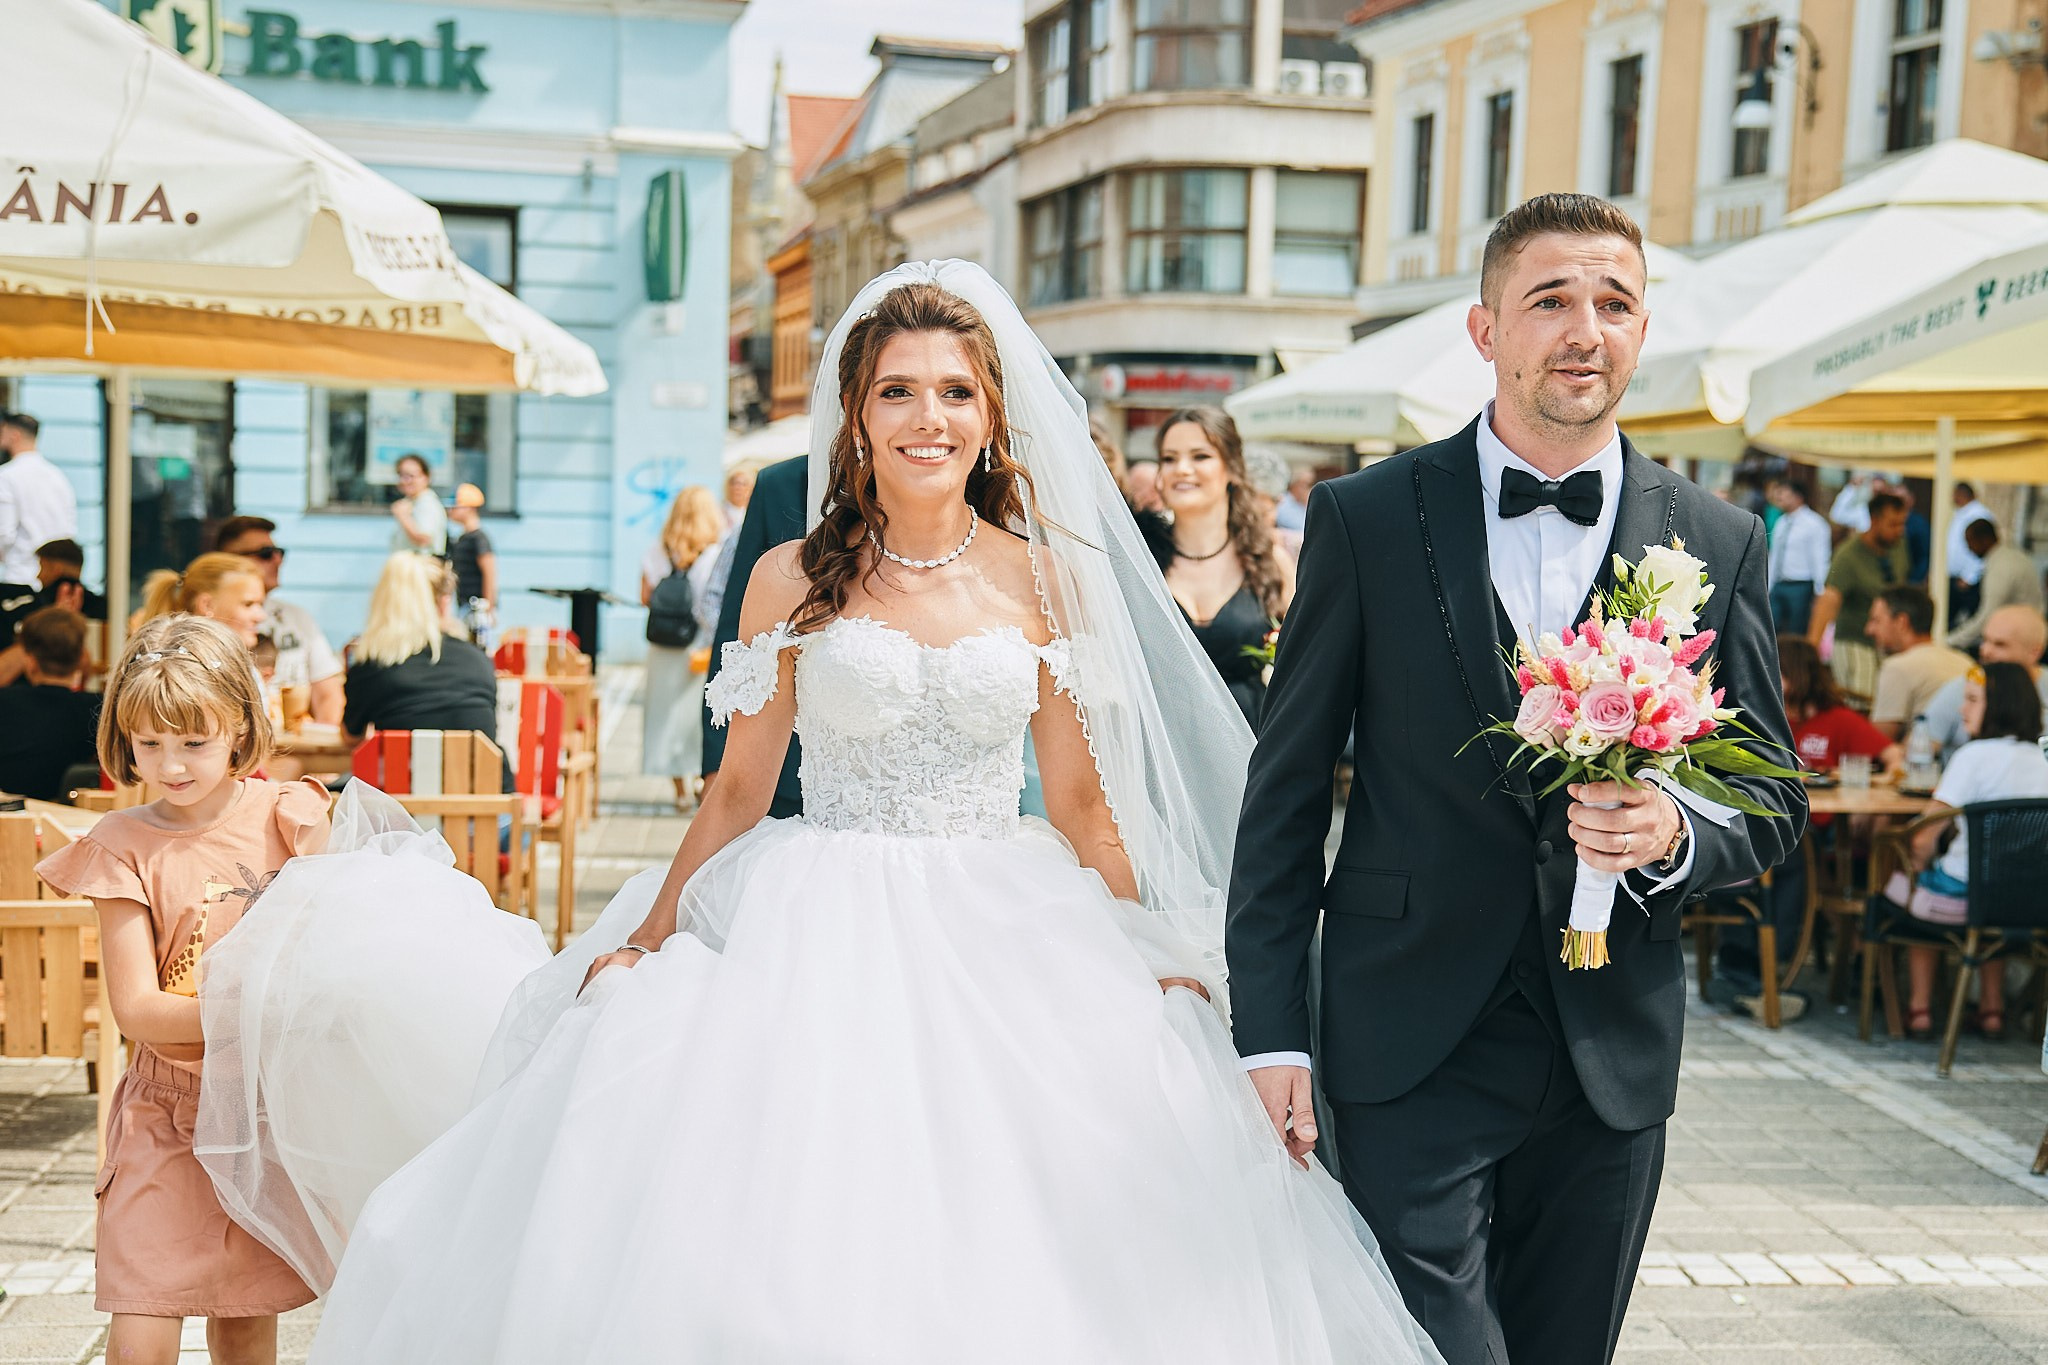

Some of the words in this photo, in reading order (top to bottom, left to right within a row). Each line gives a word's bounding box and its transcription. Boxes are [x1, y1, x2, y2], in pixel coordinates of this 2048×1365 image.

[245, 10, 490, 93] Bank
[1889, 315, 1921, 346] THE
[1924, 298, 1966, 333] BEST
